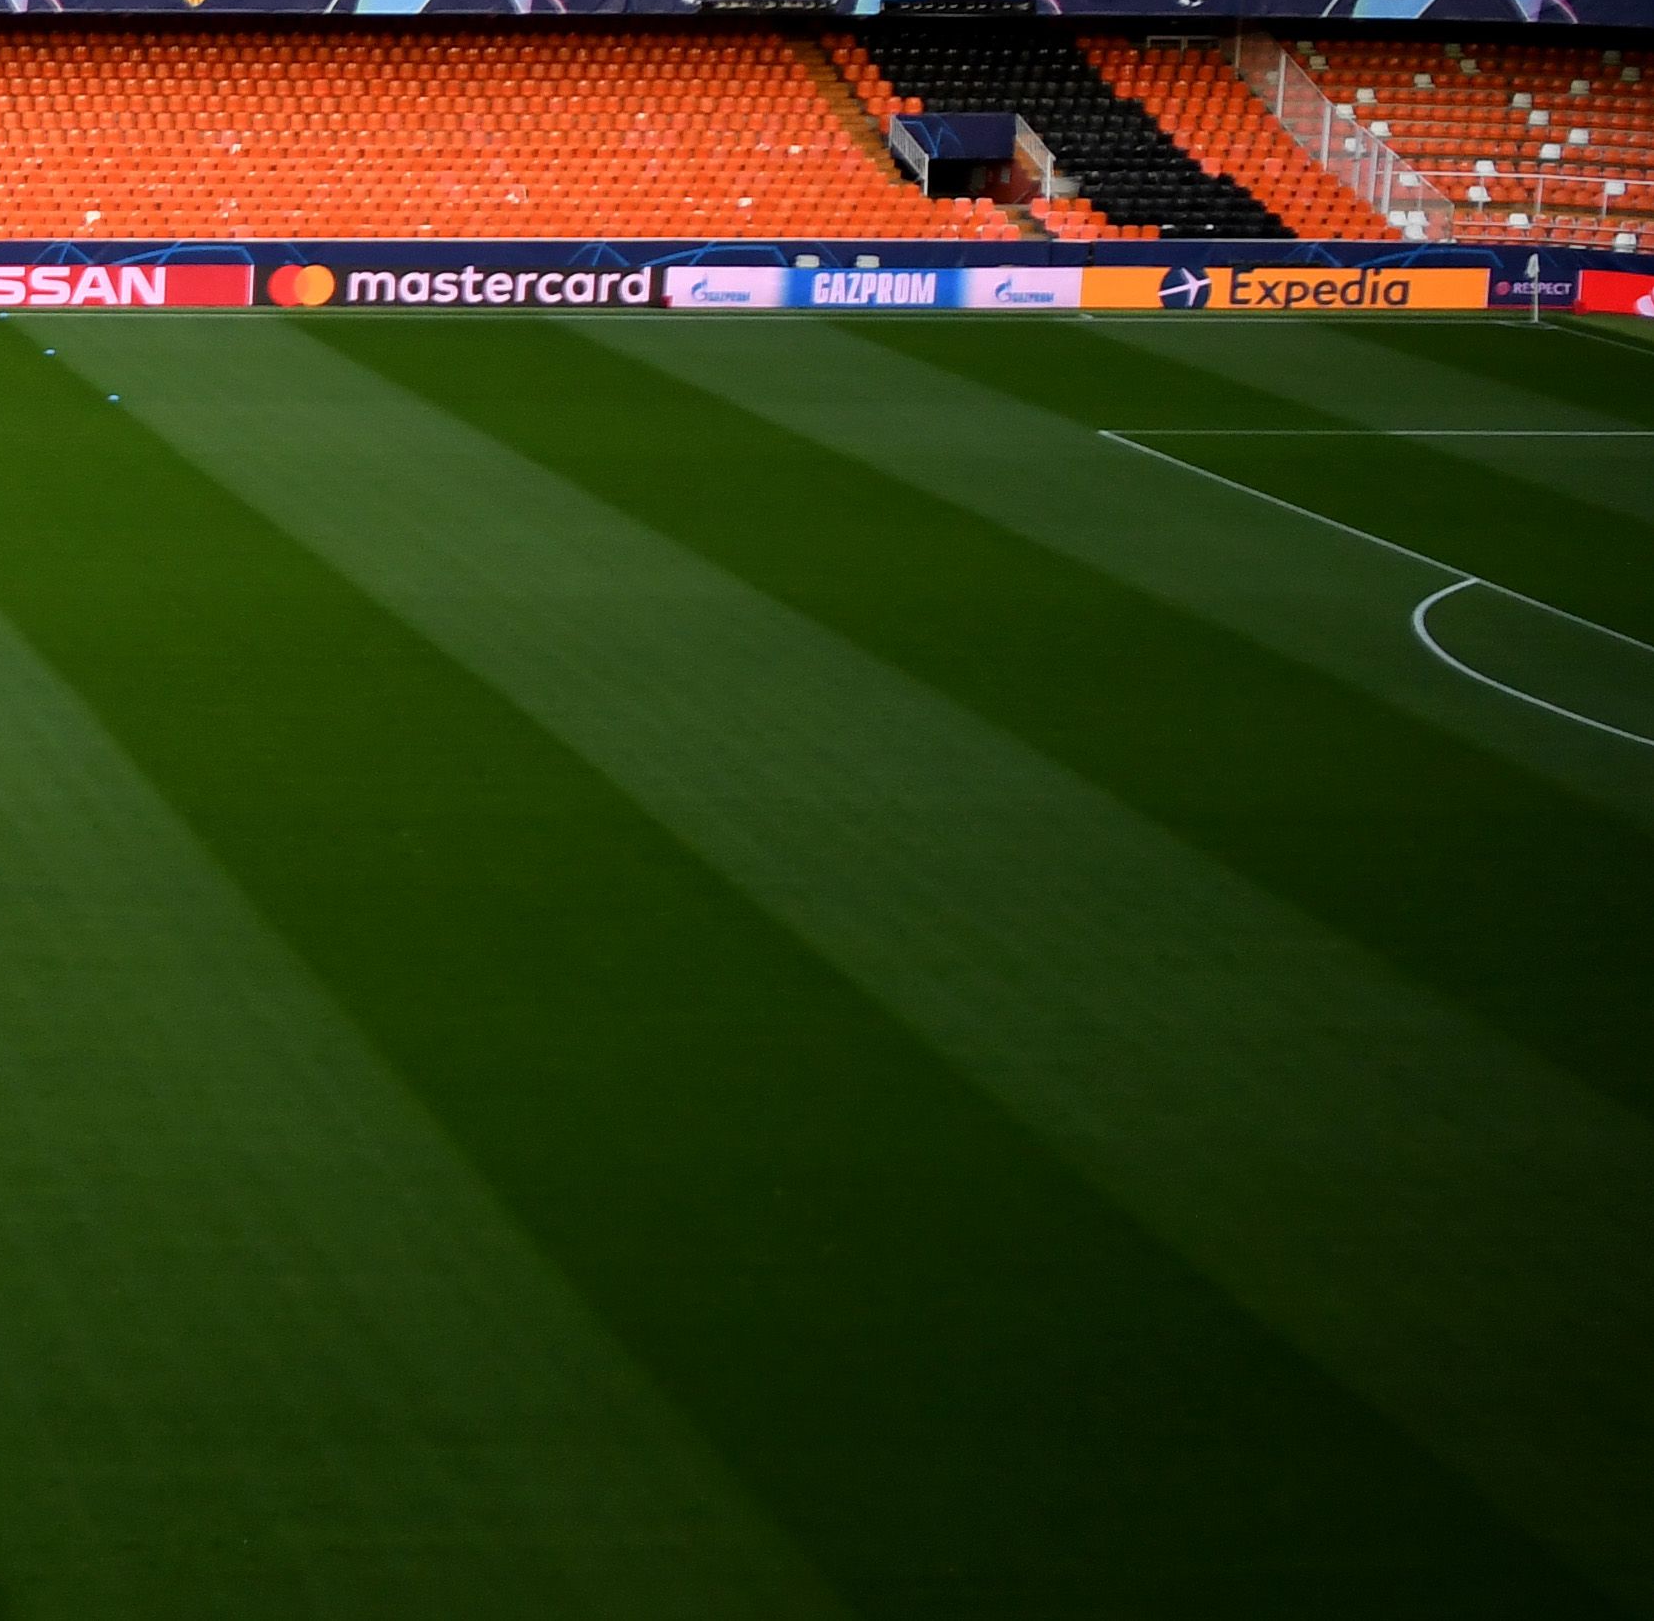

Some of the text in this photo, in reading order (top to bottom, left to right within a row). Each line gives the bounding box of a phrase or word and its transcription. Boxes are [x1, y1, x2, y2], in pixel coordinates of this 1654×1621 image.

[346, 266, 651, 305] mastercard
[813, 271, 936, 305] GAZPROM
[1228, 265, 1410, 310] Expedia
